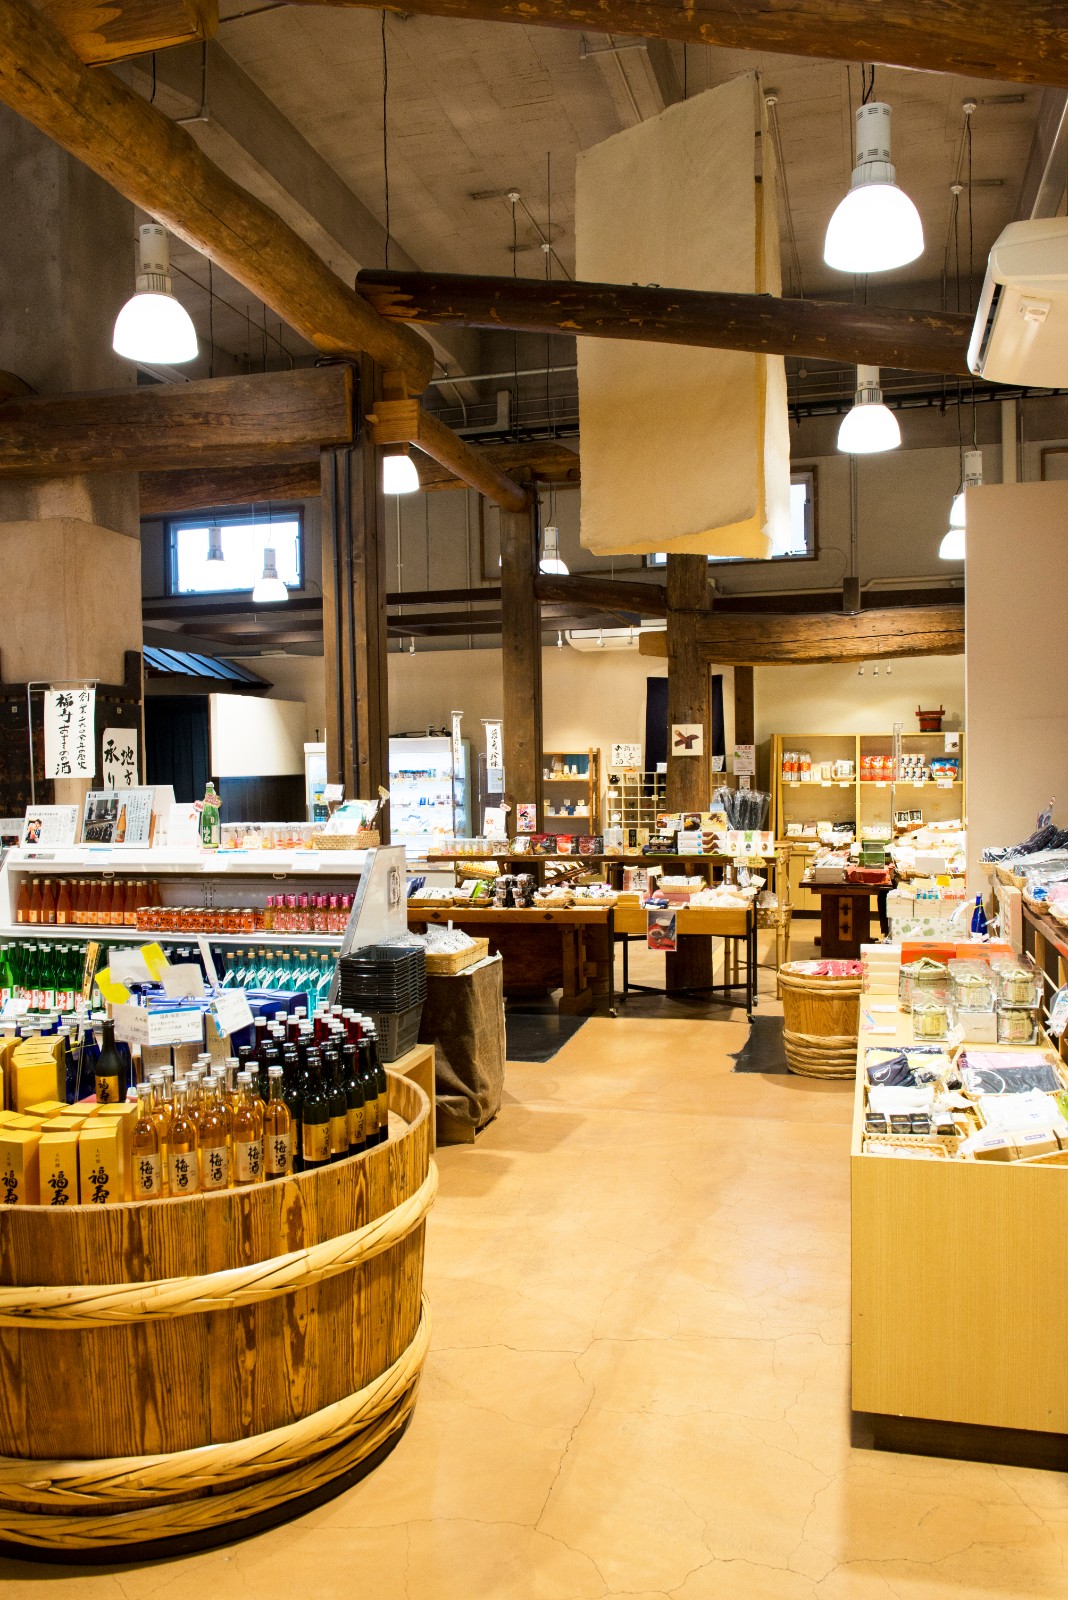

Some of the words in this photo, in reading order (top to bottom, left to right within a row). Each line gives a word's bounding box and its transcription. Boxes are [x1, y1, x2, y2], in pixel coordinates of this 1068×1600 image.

[98, 1078, 110, 1102] 福寿
[209, 1152, 223, 1182] 梅酒
[247, 1145, 260, 1175] 梅酒
[274, 1139, 287, 1168] 梅酒
[2, 1170, 19, 1205] 福寿
[48, 1170, 69, 1205] 福寿
[88, 1166, 110, 1204] 福寿
[139, 1159, 154, 1190] 梅酒
[175, 1157, 189, 1188] 梅酒
